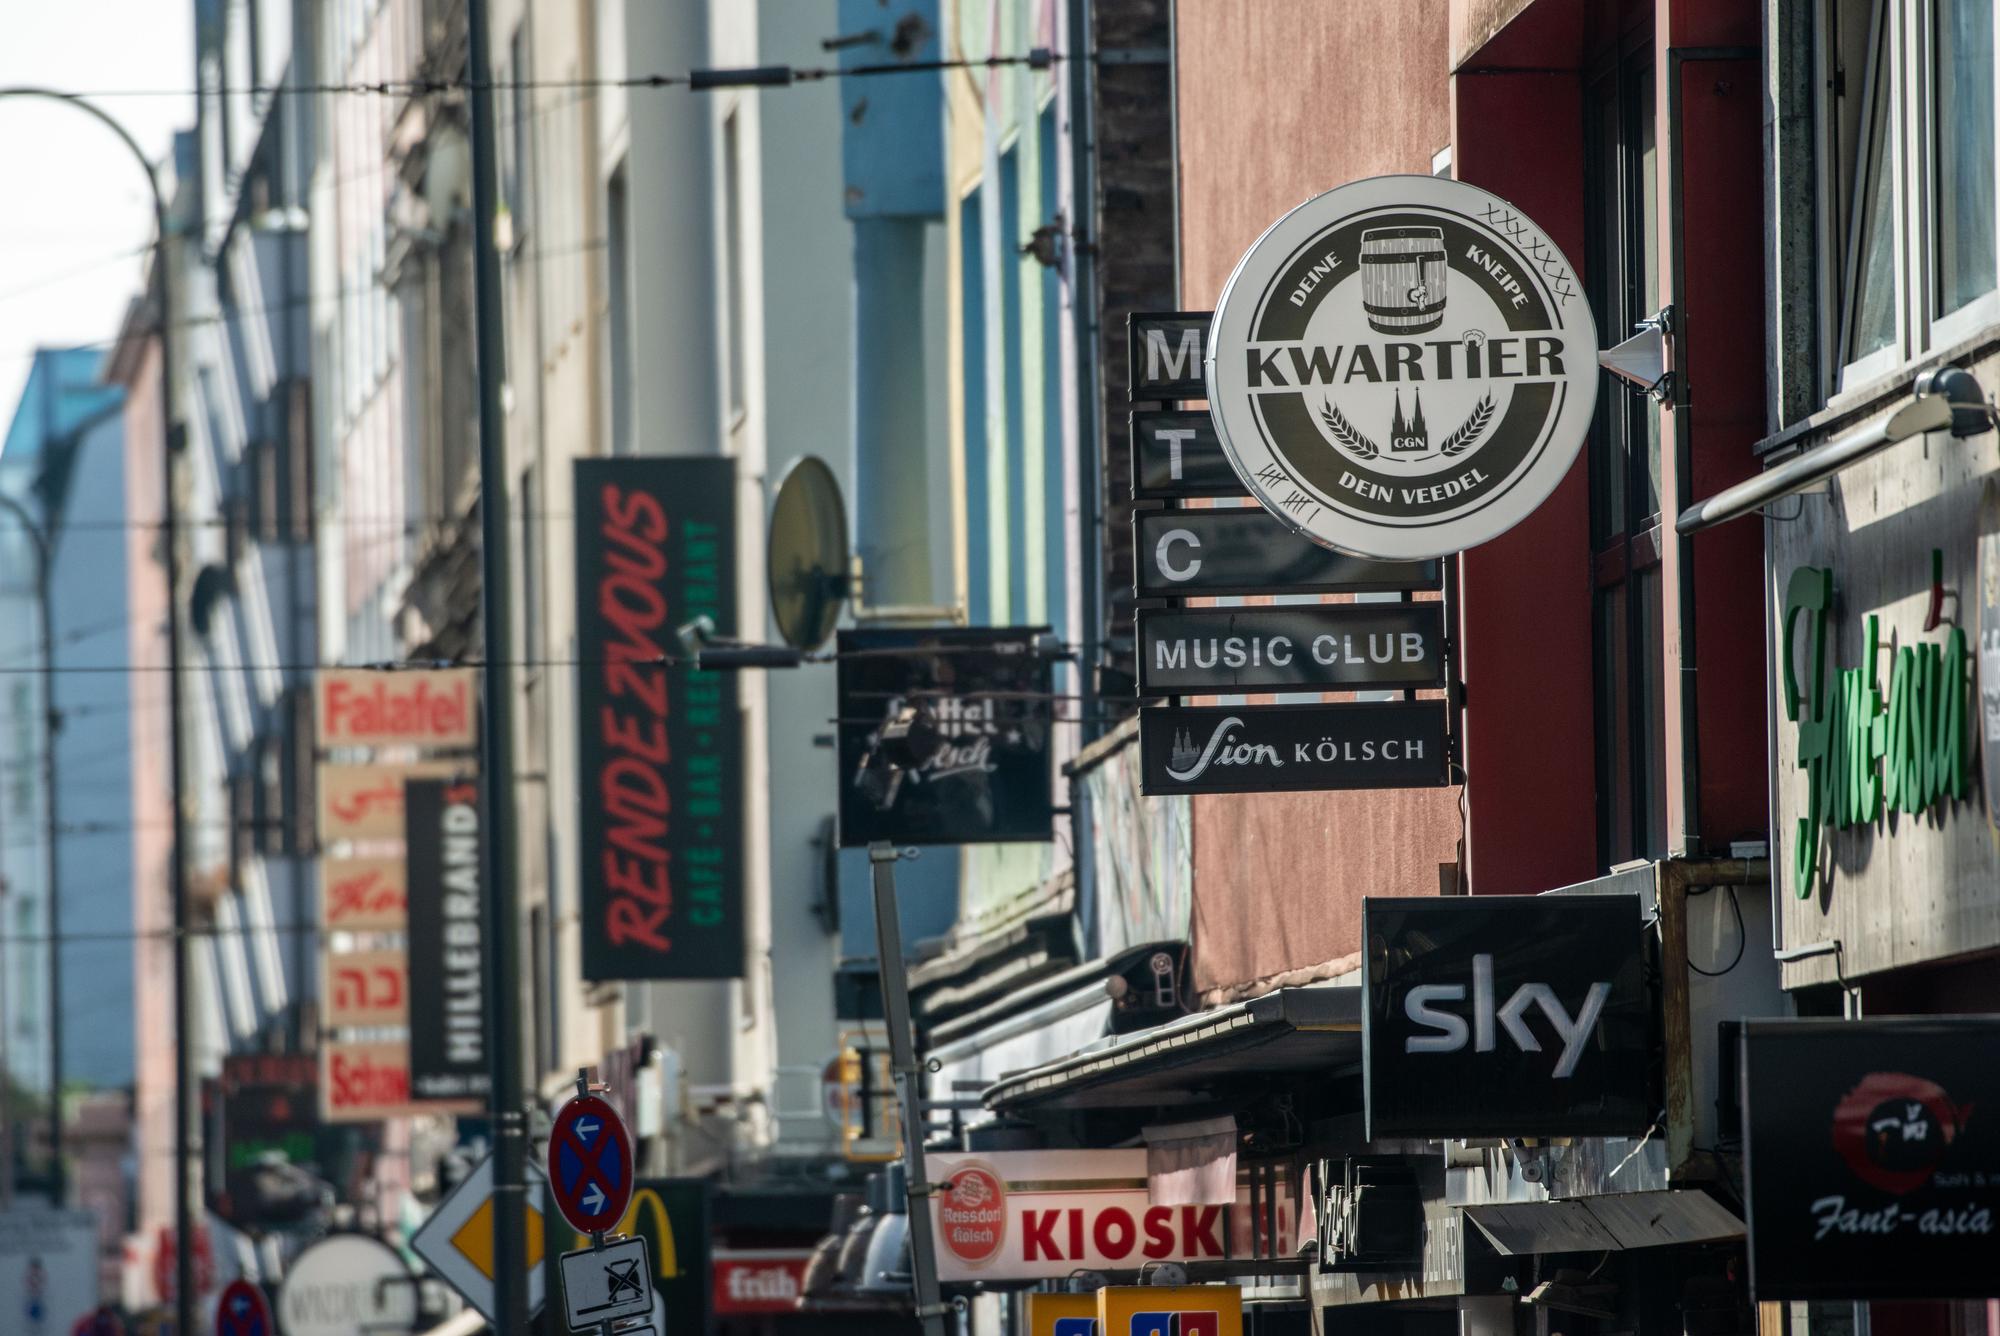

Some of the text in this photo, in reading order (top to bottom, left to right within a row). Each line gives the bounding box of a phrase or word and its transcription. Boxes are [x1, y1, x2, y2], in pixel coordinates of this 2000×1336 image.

[1289, 251, 1343, 308] DEINE
[1465, 244, 1529, 310] KNEIPE
[1146, 328, 1202, 381] M
[1246, 329, 1567, 388] KWARTIER
[1155, 429, 1196, 480] T
[1394, 436, 1426, 450] CGN
[1338, 468, 1489, 505] DEIN VEEDEL
[1155, 529, 1202, 582] C
[683, 519, 721, 727] RESURANT
[1155, 632, 1425, 670] MUSIC CLUB
[325, 680, 468, 738] Falafel
[601, 484, 672, 952] RENDEZVOUS
[1165, 716, 1424, 782] Sion KÖLSCH
[687, 753, 722, 817] BAR
[1404, 953, 1612, 1079] sky
[1022, 1204, 1226, 1261] KIOSK
[1810, 1195, 1994, 1241] Fant-asia
